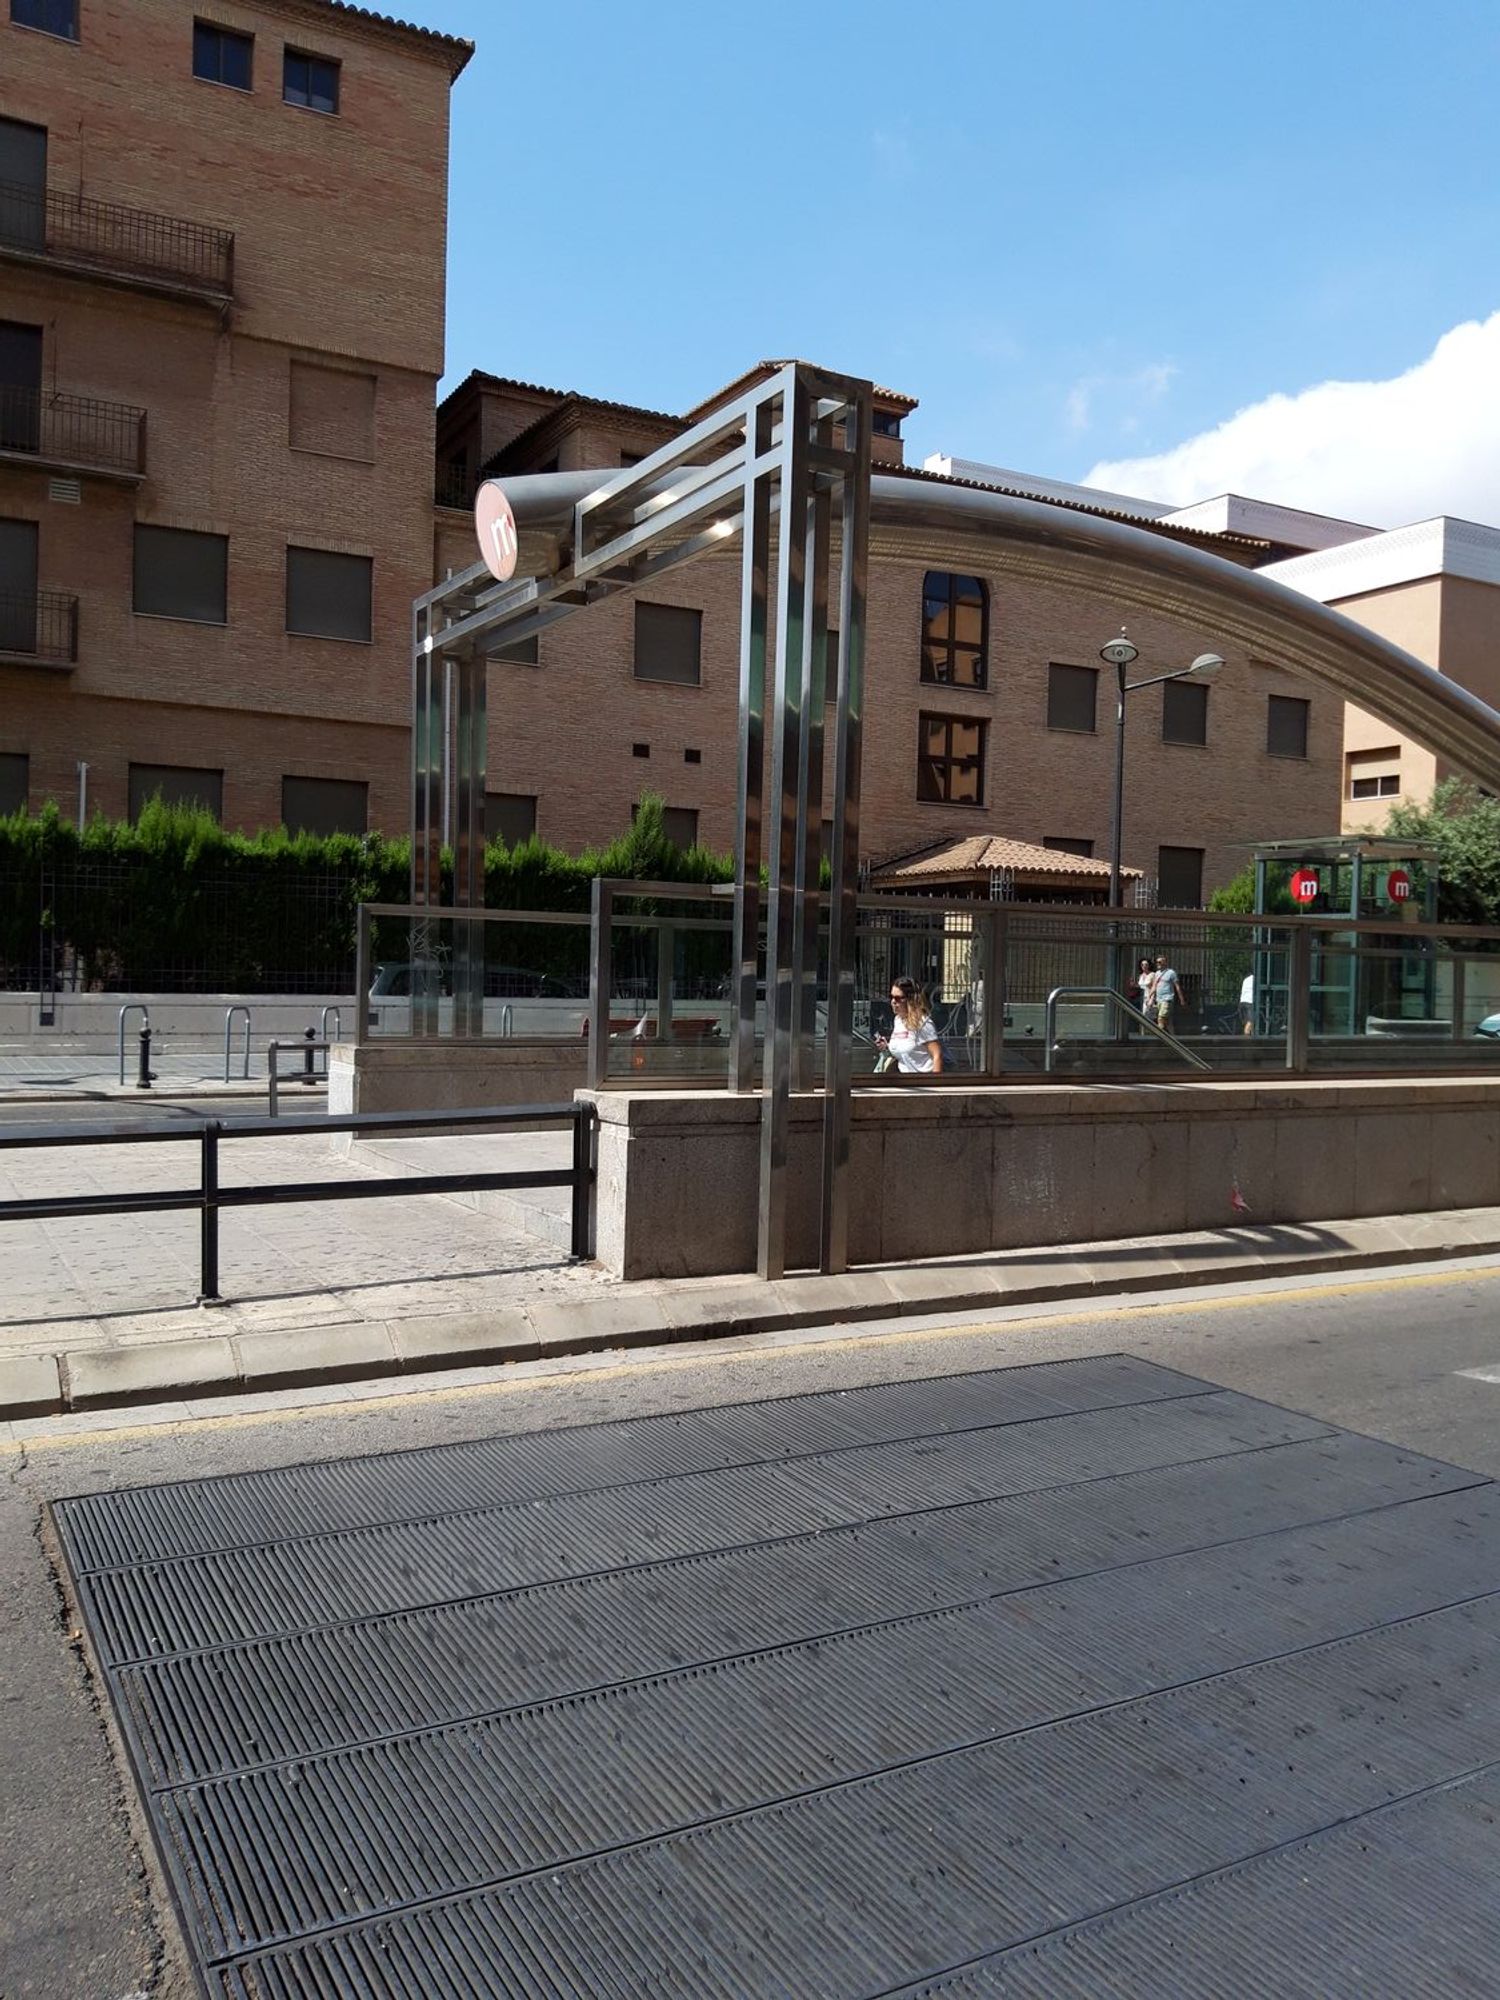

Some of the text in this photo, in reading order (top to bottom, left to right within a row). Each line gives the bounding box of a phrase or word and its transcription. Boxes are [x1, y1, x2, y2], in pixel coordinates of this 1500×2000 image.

[490, 512, 516, 560] m
[1300, 880, 1317, 896] m
[1395, 881, 1409, 897] m
